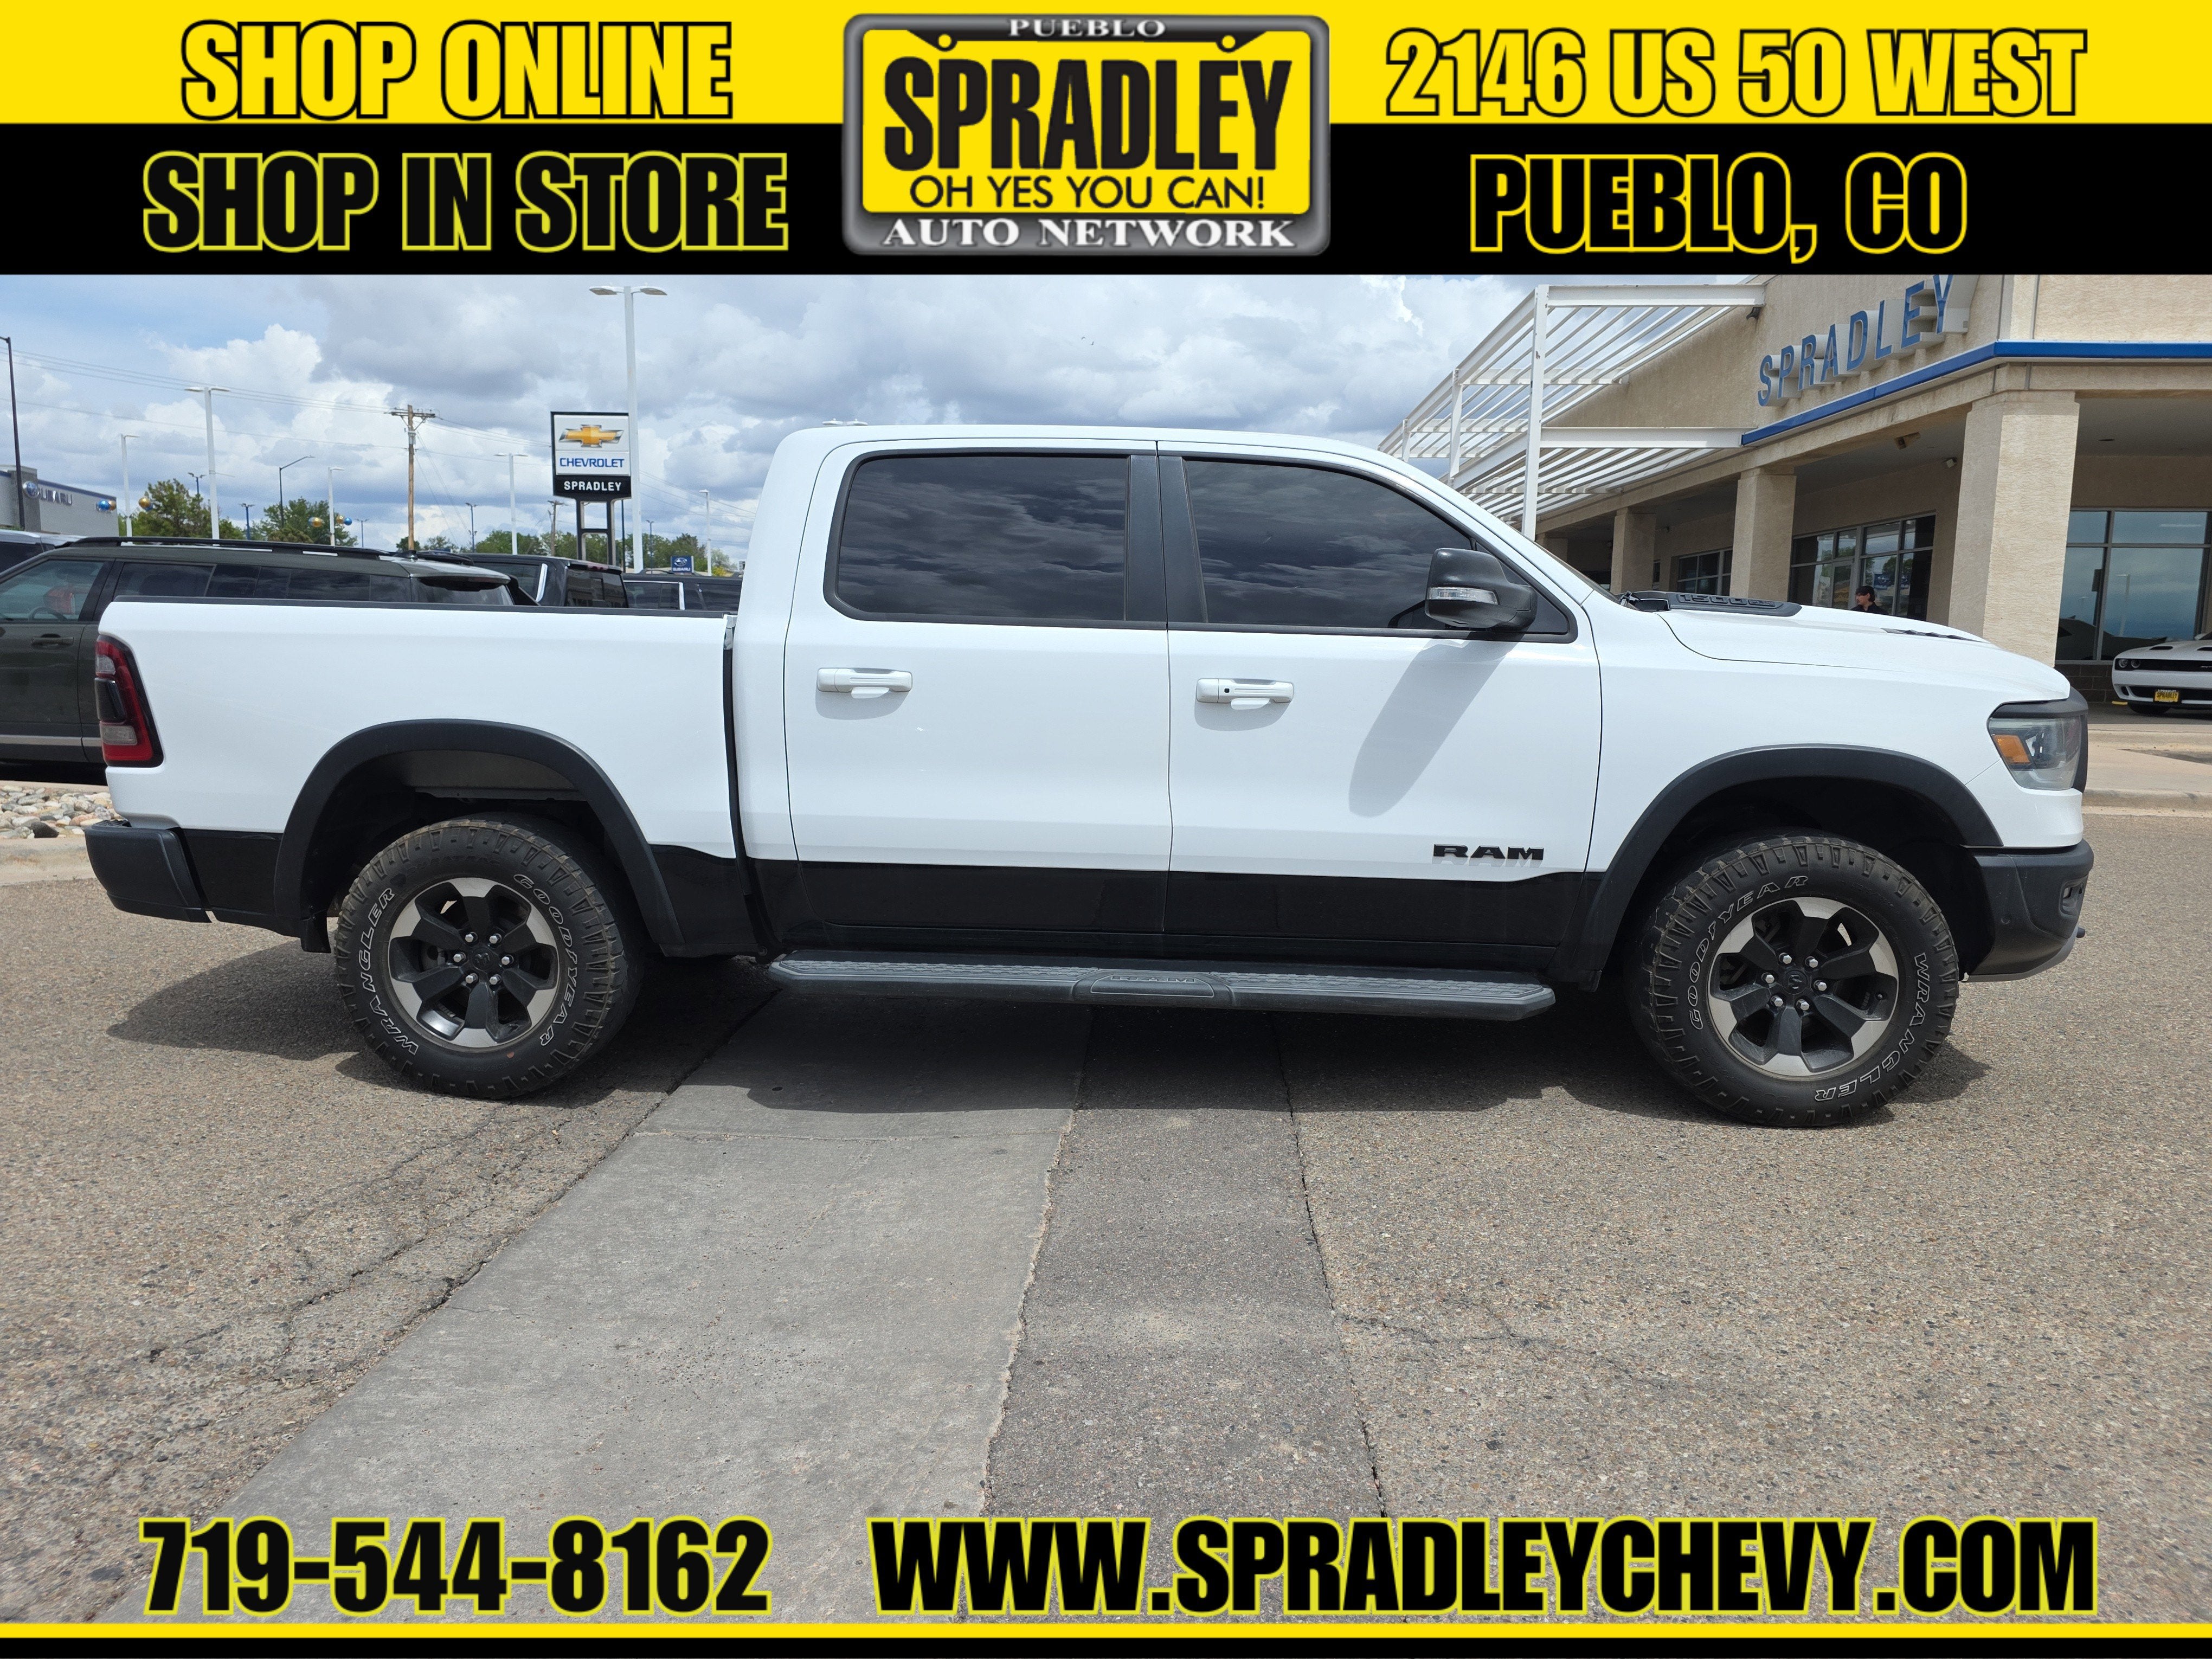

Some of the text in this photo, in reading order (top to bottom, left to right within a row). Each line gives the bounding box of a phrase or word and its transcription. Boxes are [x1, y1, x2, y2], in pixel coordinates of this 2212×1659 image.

[1758, 274, 1953, 406] SPRADLEY
[560, 458, 625, 467] CHEVROLET
[564, 481, 621, 491] SPRADLEY
[1433, 844, 1544, 860] RAM
[358, 888, 420, 1056] WRANGLER
[513, 874, 578, 1046] GOODYEAR
[1688, 875, 1809, 1030] GOODYEAR
[1815, 952, 1931, 1102] WRANGLER
